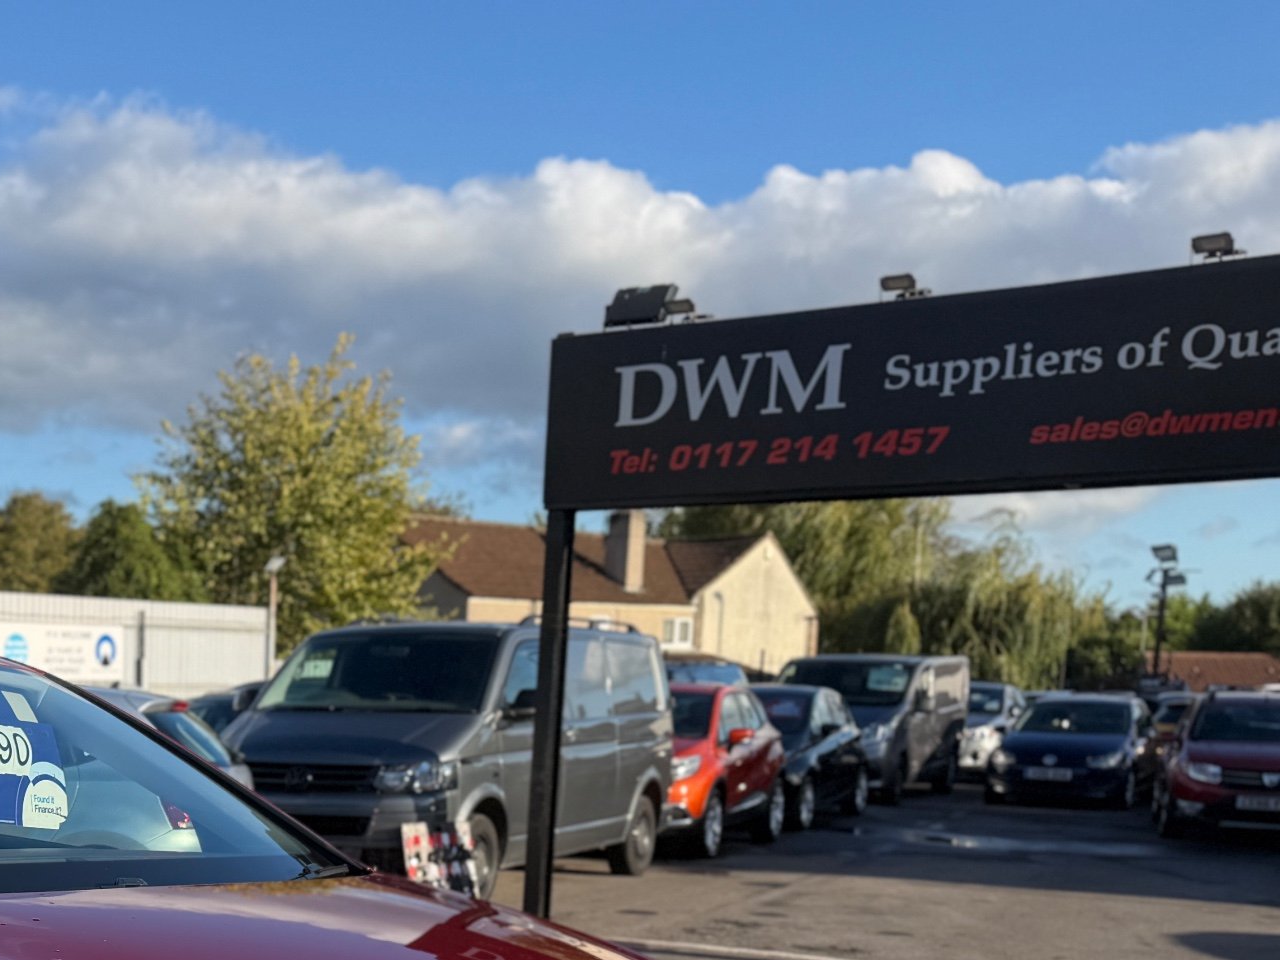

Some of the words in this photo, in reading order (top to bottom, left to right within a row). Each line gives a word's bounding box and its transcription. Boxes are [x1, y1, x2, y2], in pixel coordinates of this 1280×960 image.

[884, 341, 1104, 397] Suppliers
[1117, 327, 1171, 370] of
[1181, 323, 1280, 370] Qua
[614, 343, 852, 427] DWM
[609, 448, 658, 475] Tel:
[669, 439, 758, 471] 0117
[765, 434, 840, 464] 214
[852, 426, 951, 459] 1457
[33, 794, 50, 804] Found
[34, 804, 54, 814] Finance
